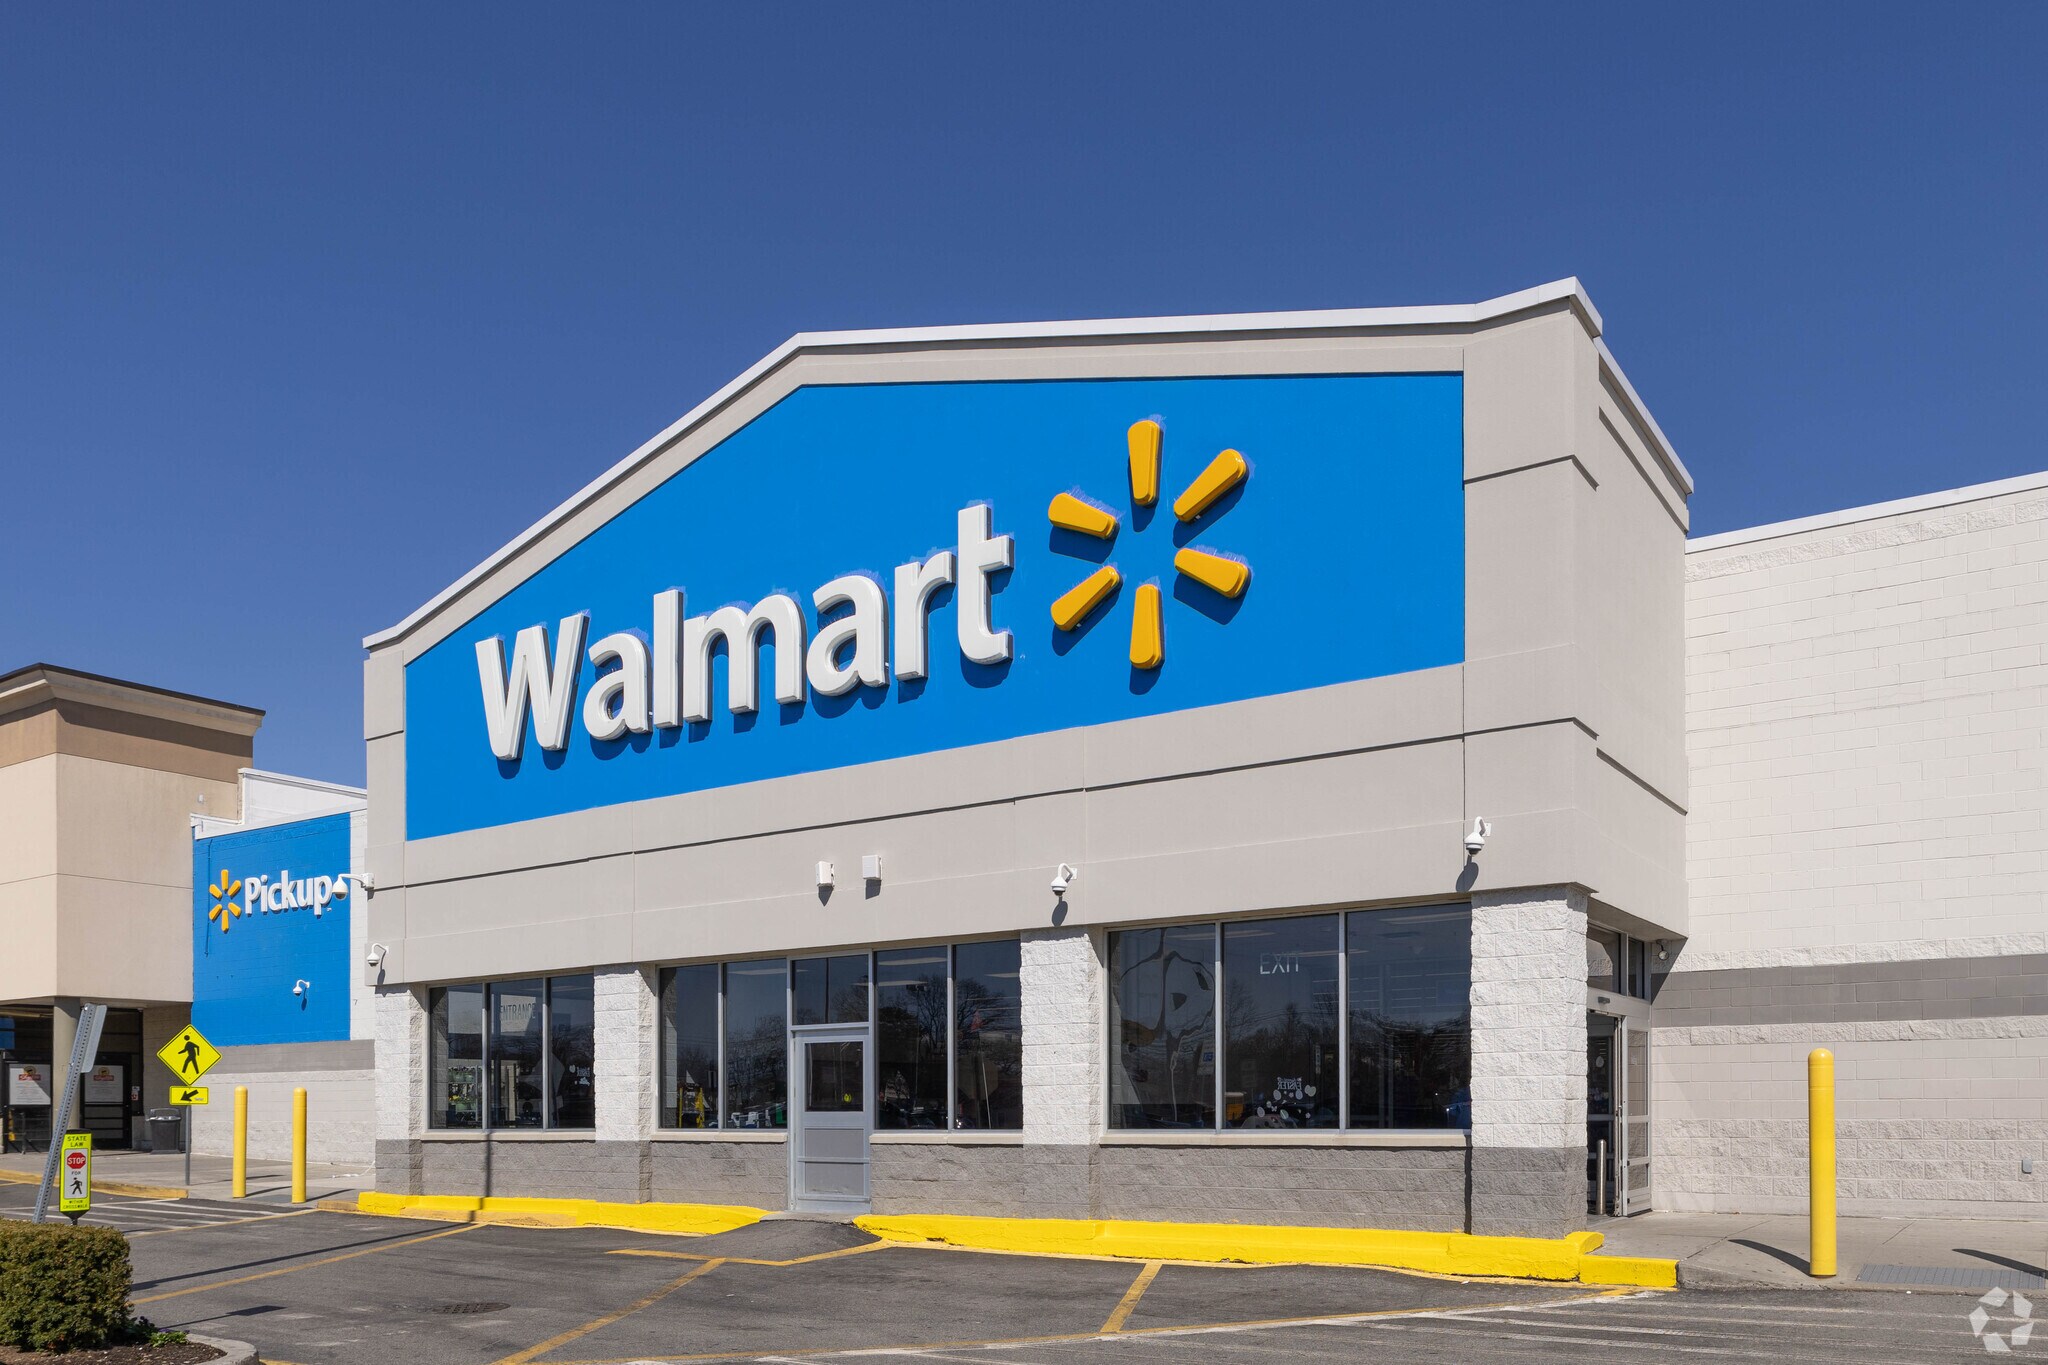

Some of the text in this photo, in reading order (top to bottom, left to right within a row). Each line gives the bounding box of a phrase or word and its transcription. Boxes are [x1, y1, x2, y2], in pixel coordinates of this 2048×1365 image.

[475, 503, 1014, 761] Walmart
[244, 870, 333, 916] Pickup
[1260, 952, 1302, 974] EXIT
[499, 1003, 536, 1021] ENTRANCE
[67, 1157, 86, 1165] STOP
